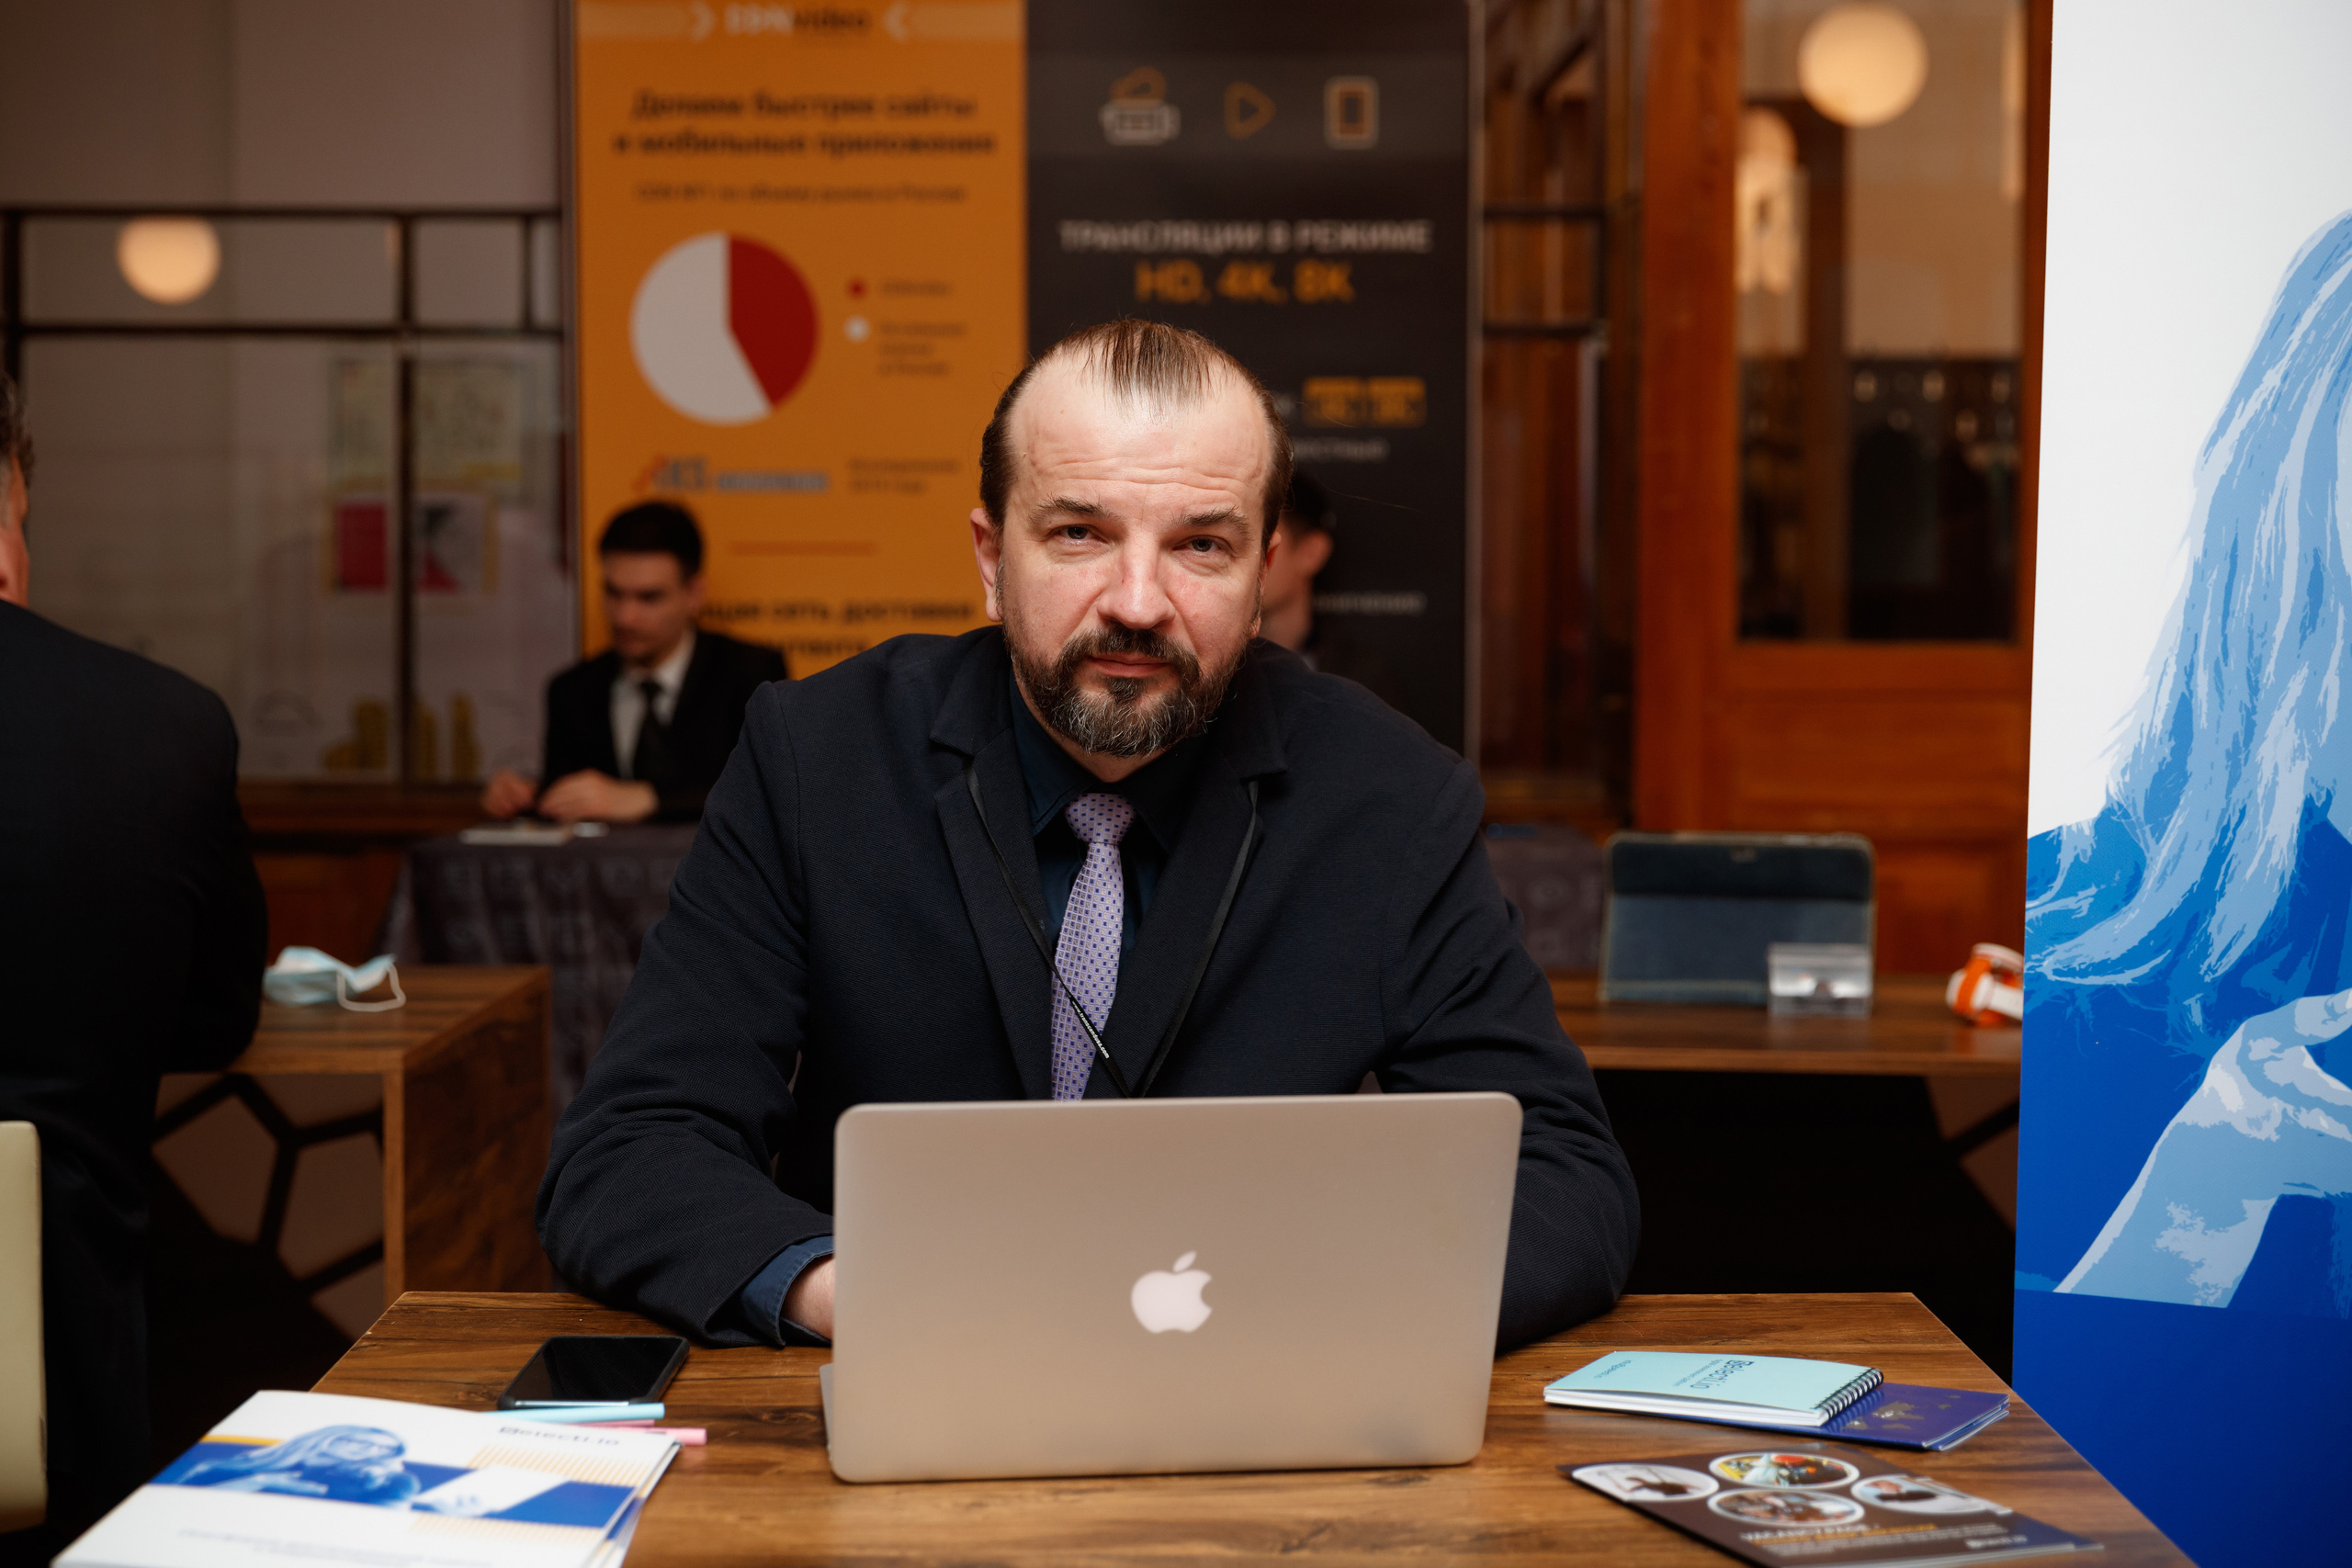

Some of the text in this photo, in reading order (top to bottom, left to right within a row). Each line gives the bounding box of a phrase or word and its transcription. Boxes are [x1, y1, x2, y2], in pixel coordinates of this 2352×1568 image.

[1058, 220, 1264, 256] ТРАНСЛЯЦИИ
[1295, 220, 1434, 254] РЕЖИМЕ
[1071, 1001, 1110, 1058] www.transcendusa.com
